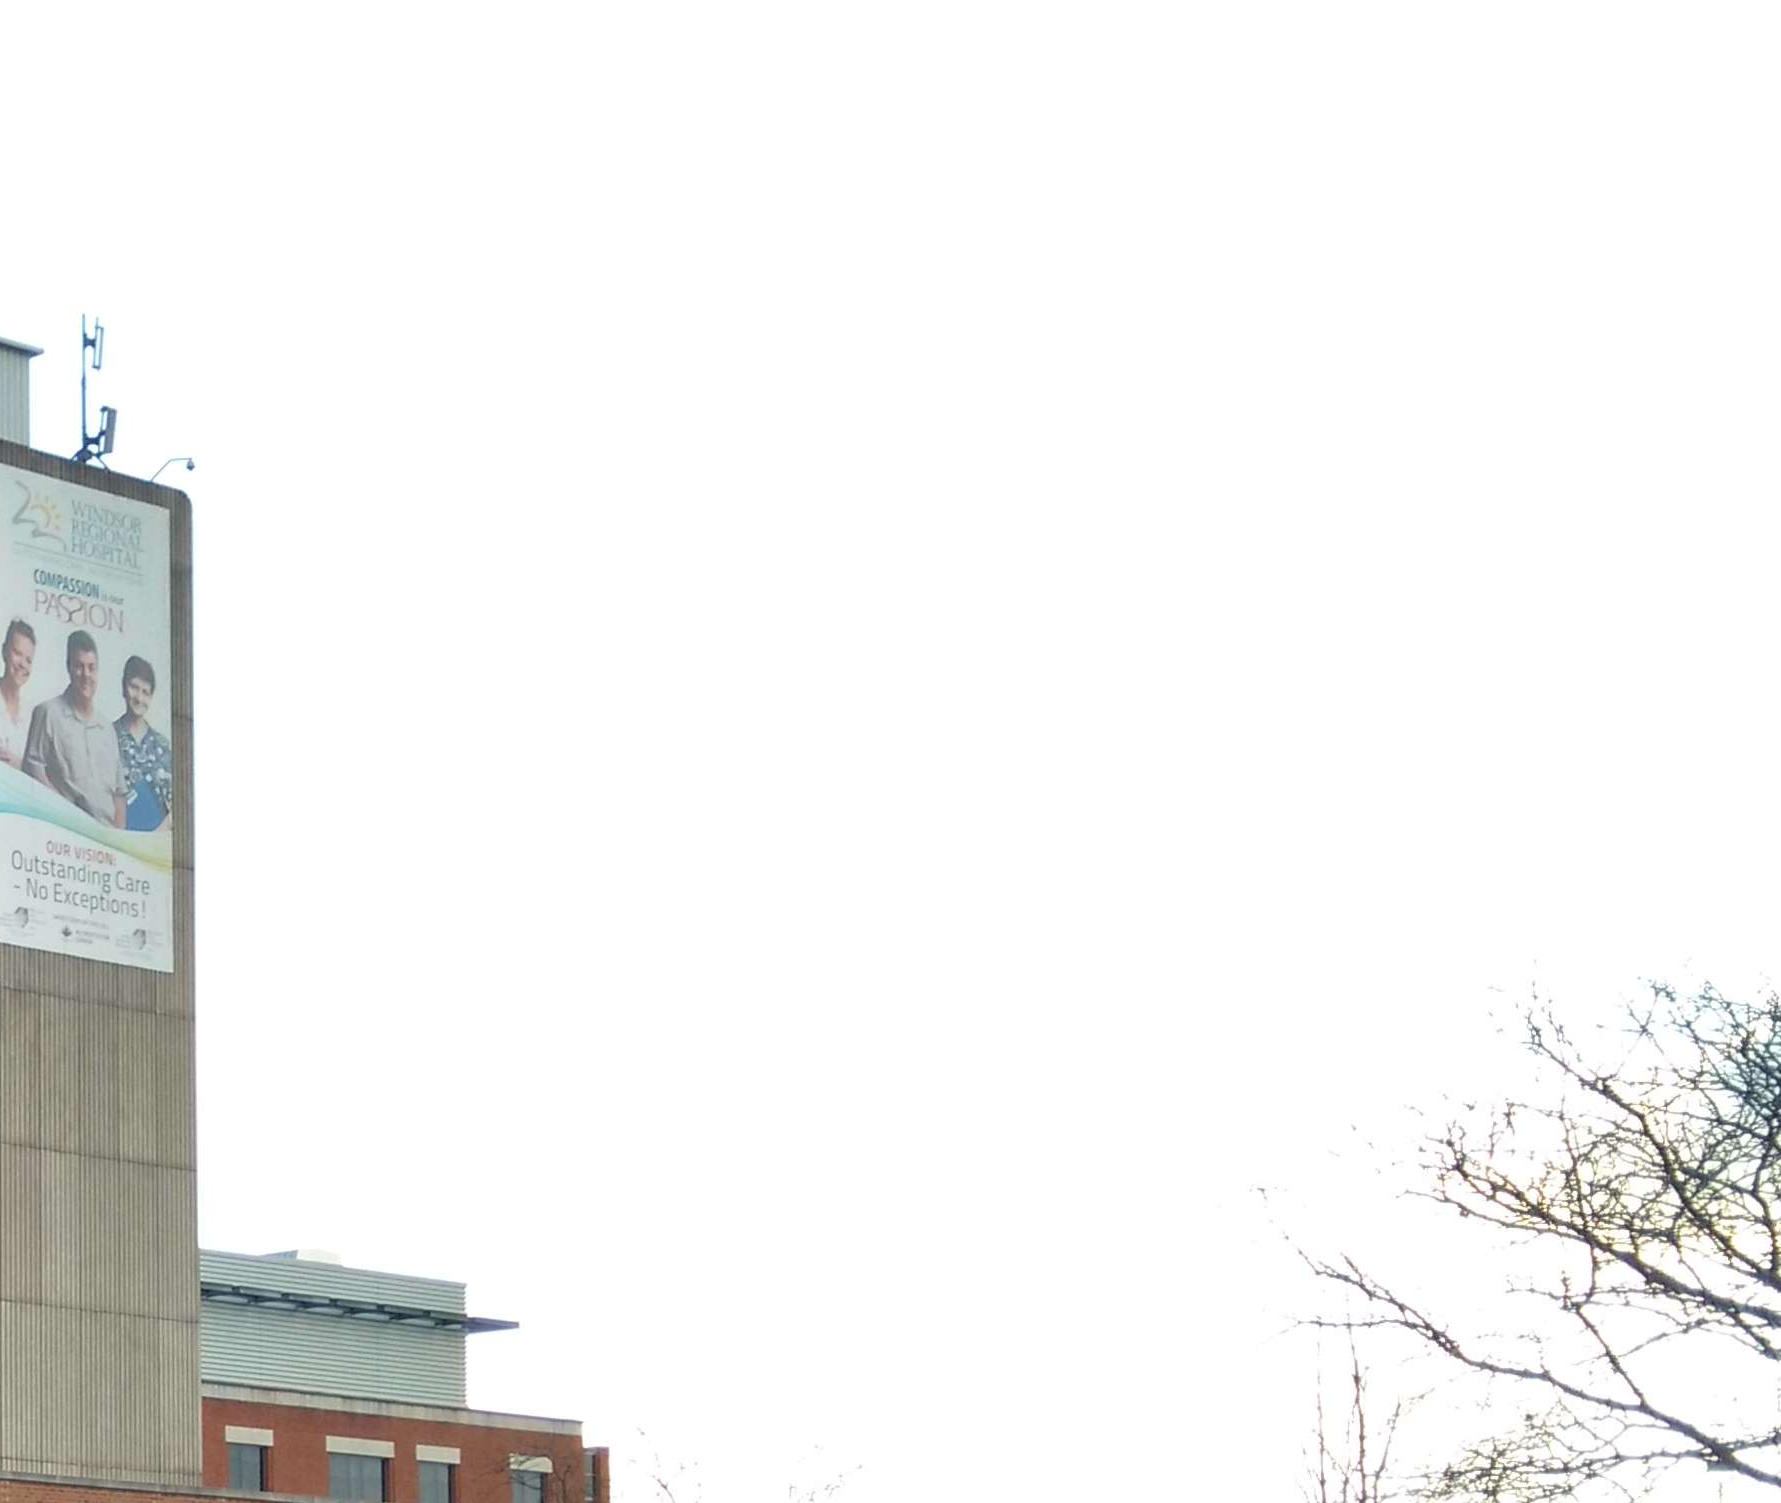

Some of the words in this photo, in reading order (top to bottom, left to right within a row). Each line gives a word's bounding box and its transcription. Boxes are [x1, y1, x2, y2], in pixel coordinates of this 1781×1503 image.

[34, 569, 100, 599] COMPASSION
[34, 589, 124, 633] PASSION
[46, 840, 71, 857] OUR
[11, 850, 111, 894] Outstanding
[115, 870, 150, 896] Care
[26, 878, 48, 900] No
